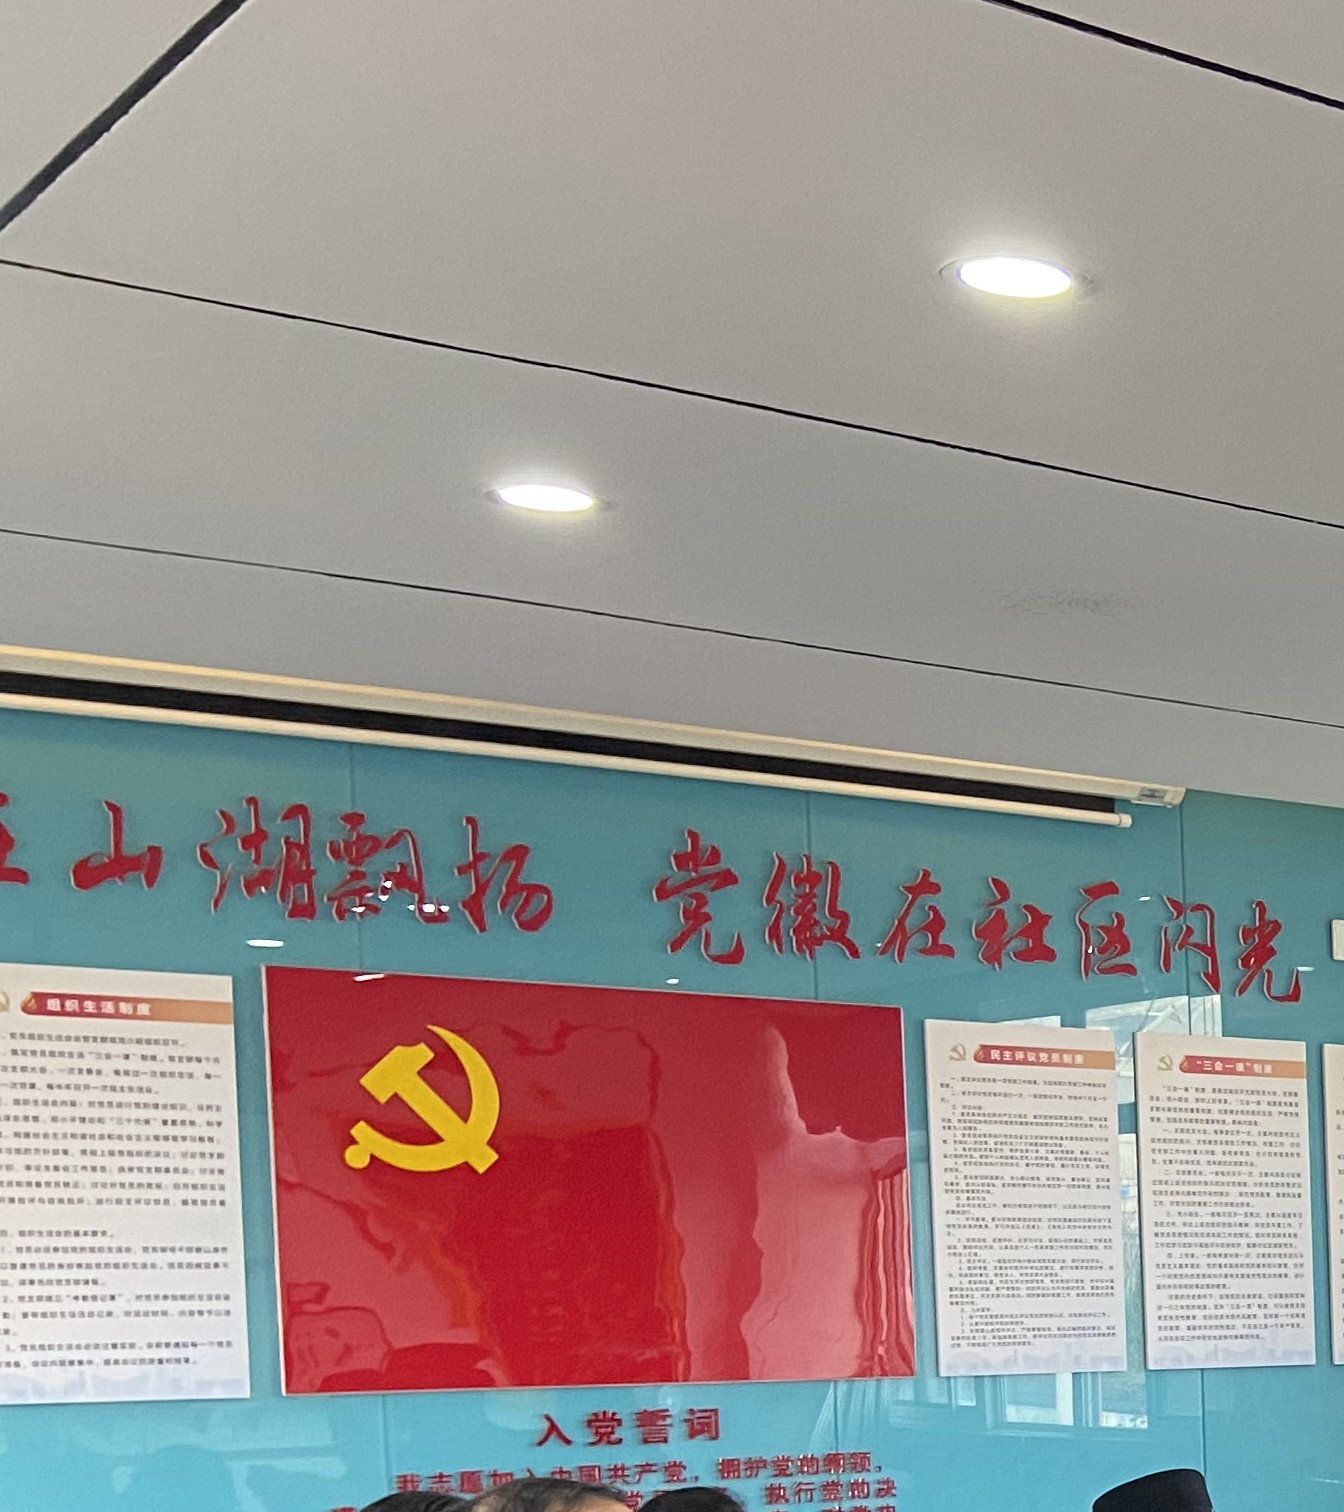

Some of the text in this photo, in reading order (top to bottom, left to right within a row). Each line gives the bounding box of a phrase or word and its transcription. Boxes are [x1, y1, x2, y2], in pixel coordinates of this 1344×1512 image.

[652, 828, 1302, 1004] 党徽在社区闪光
[47, 998, 151, 1016] 组织生活制度
[990, 1049, 1084, 1065] 民主评议党员制度
[535, 1408, 722, 1447] 入党誓词
